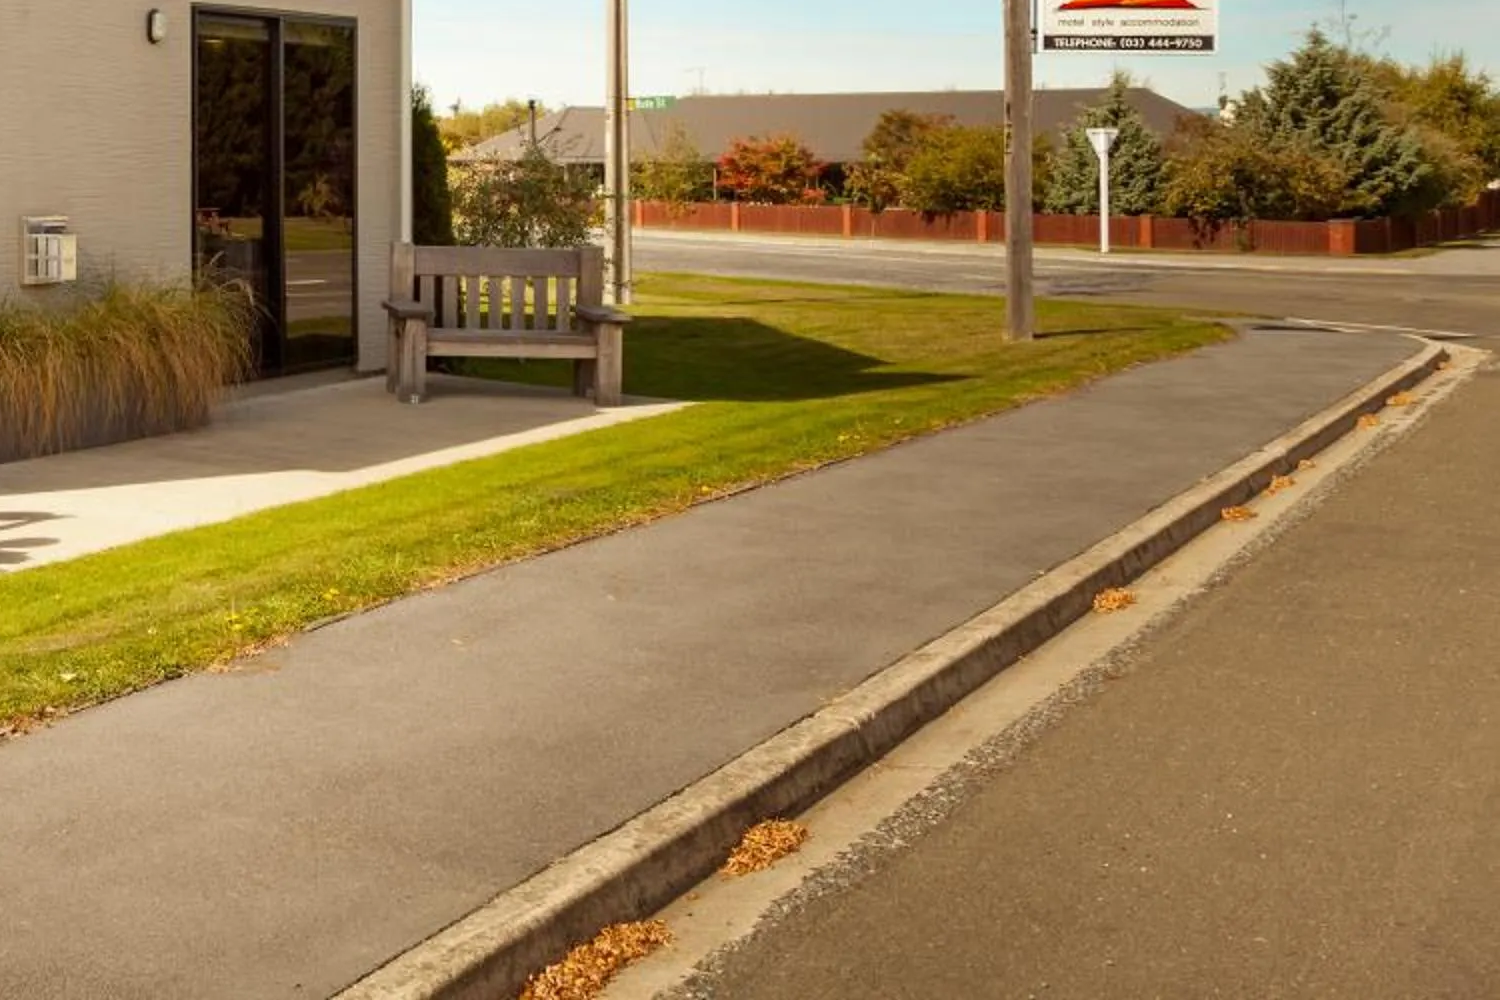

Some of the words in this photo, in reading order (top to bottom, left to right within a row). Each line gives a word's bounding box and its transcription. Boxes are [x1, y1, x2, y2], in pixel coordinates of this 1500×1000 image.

[1057, 18, 1085, 27] motel
[1091, 18, 1115, 28] style
[1120, 18, 1200, 27] accommodation
[1119, 37, 1145, 49] (03)
[1147, 37, 1204, 48] 444-9750
